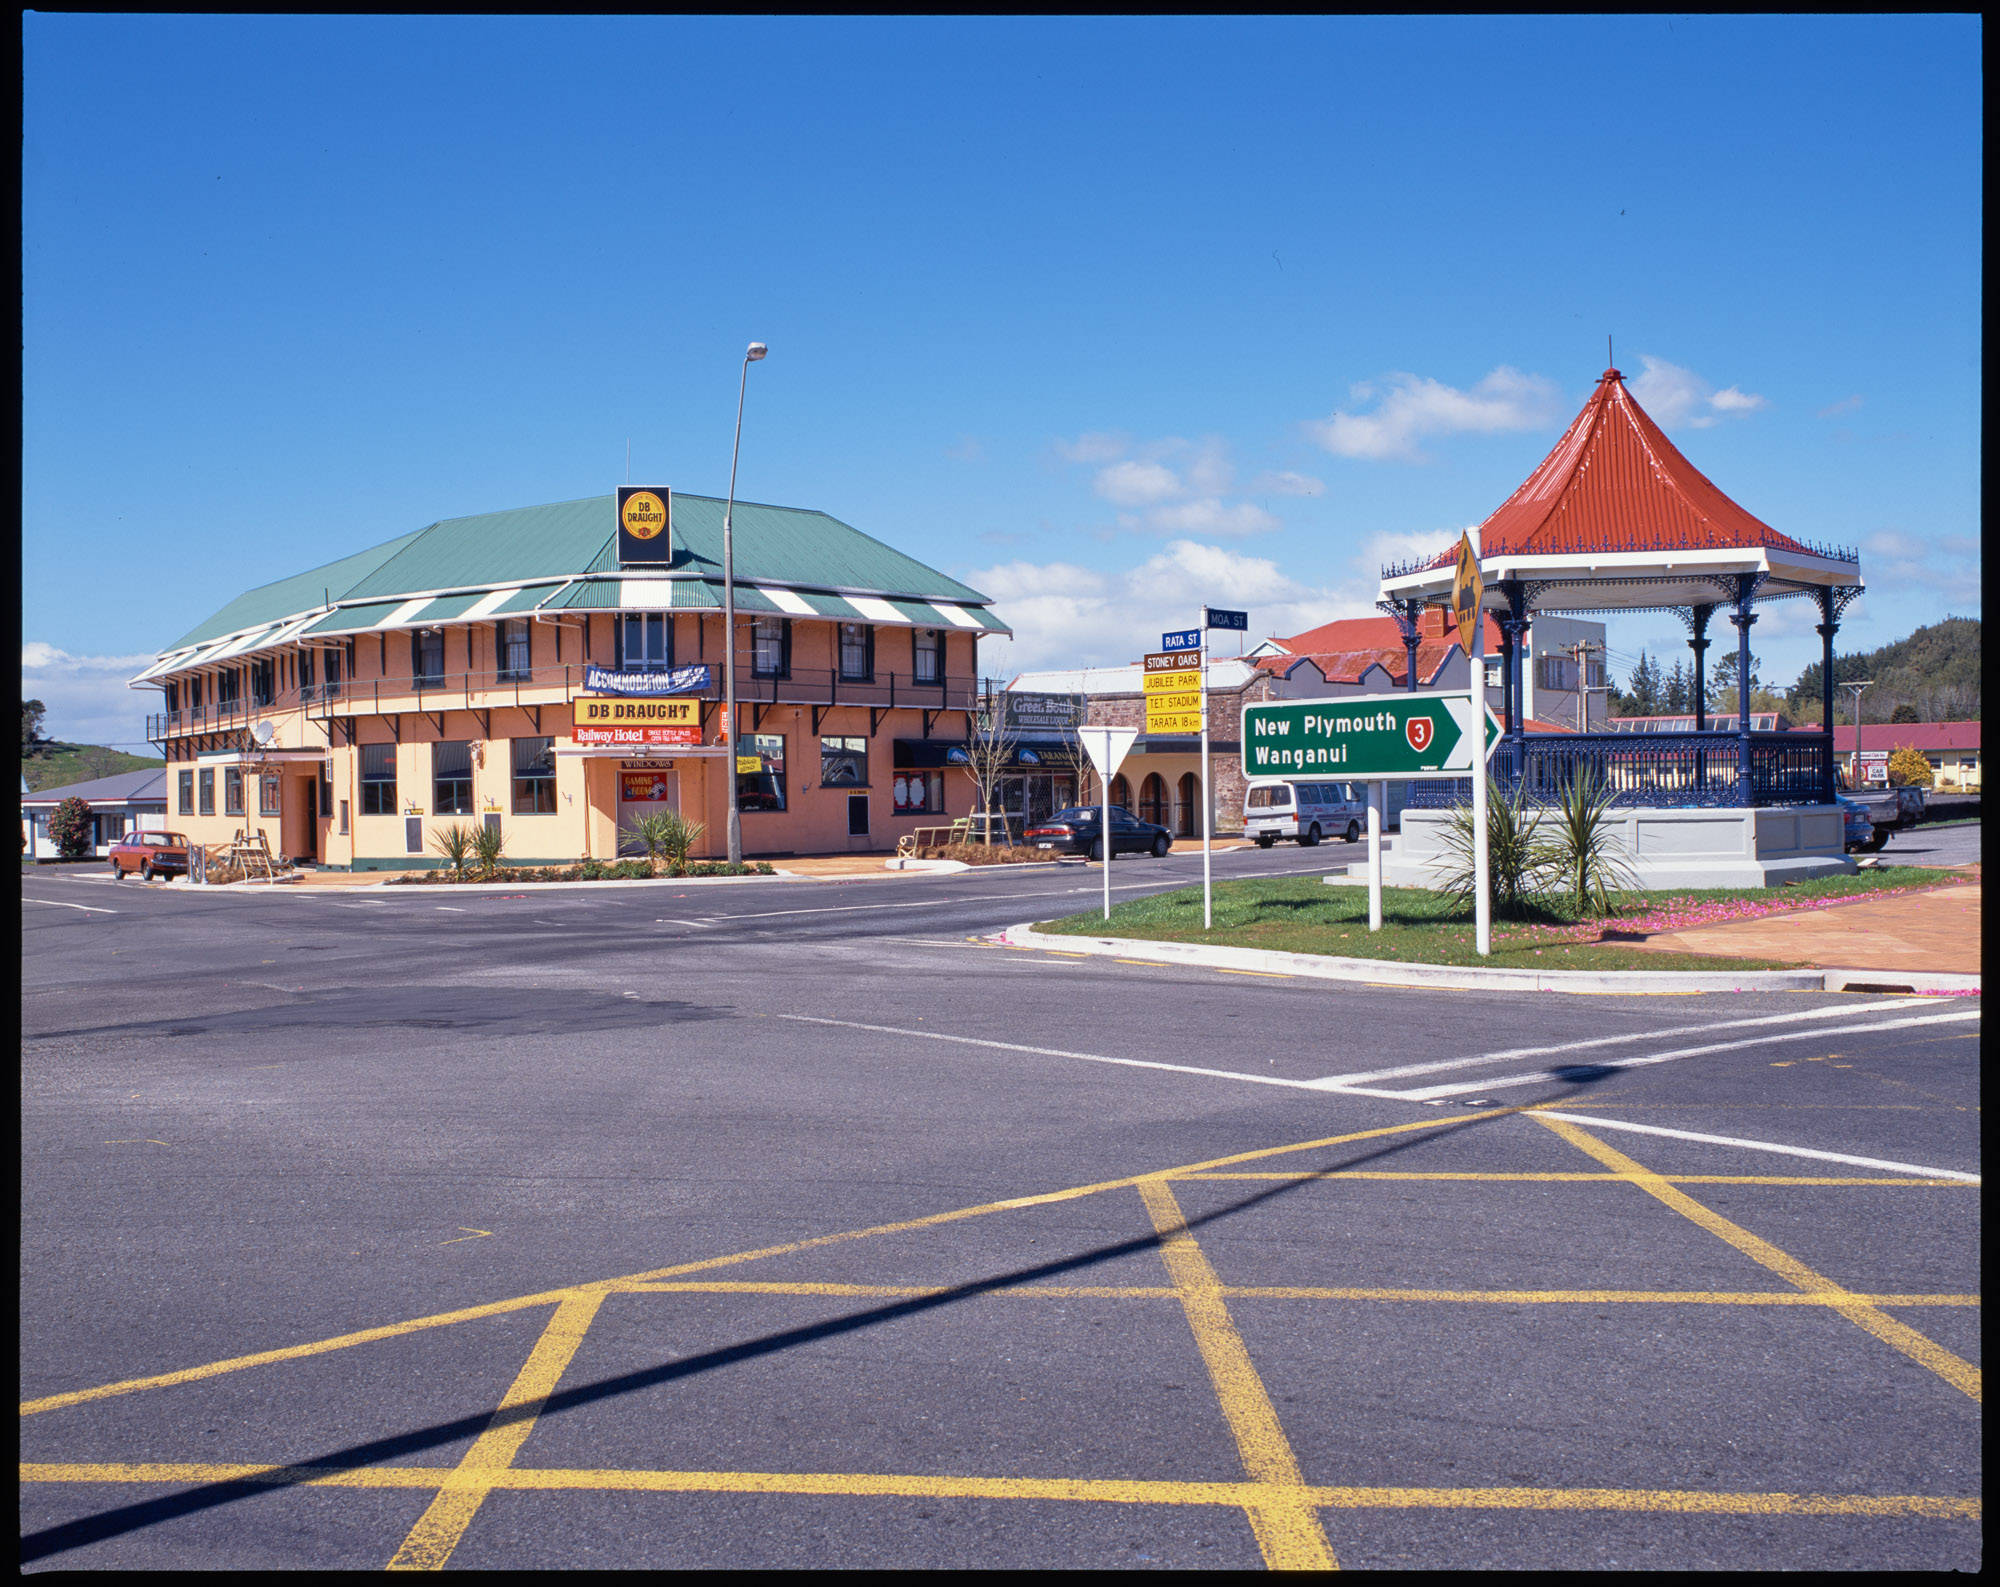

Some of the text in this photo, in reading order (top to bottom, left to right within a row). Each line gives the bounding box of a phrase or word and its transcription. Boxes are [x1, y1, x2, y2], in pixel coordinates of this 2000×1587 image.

[638, 502, 651, 512] DB
[627, 512, 663, 522] DRAUGHT
[1211, 613, 1244, 626] MOA ST
[1165, 633, 1198, 648] RATA ST
[1147, 654, 1198, 669] STONEY OAKS
[588, 670, 670, 691] ACCOMMODATION
[1146, 675, 1198, 689] JUBILEE PARK
[1013, 697, 1045, 713] Green
[1168, 696, 1199, 708] STADIUM
[588, 704, 690, 720] DB DRAUGHT
[1150, 717, 1178, 729] TARATA
[1254, 712, 1397, 739] New Plymouth
[577, 729, 643, 743] Railway Hotel
[1413, 723, 1426, 743] 3
[1255, 744, 1348, 769] Wanganui
[624, 760, 672, 768] WINDOWS
[625, 776, 653, 785] GAMING
